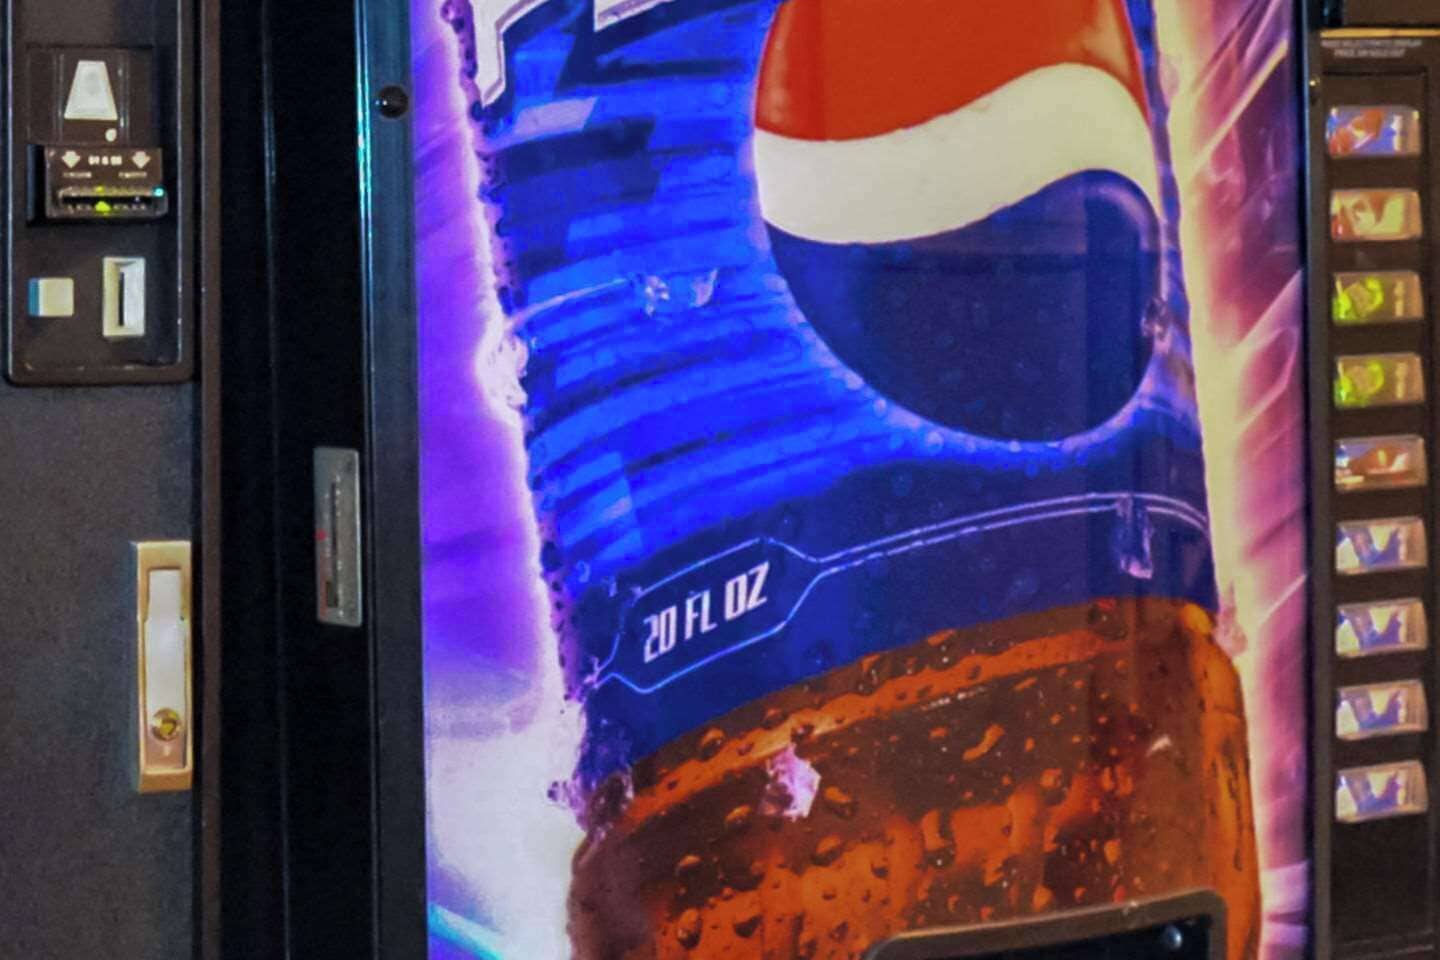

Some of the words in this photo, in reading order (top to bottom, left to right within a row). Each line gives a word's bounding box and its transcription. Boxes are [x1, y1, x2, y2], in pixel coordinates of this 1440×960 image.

[643, 605, 678, 663] 20
[683, 590, 718, 640] FL
[724, 561, 771, 620] OZ
